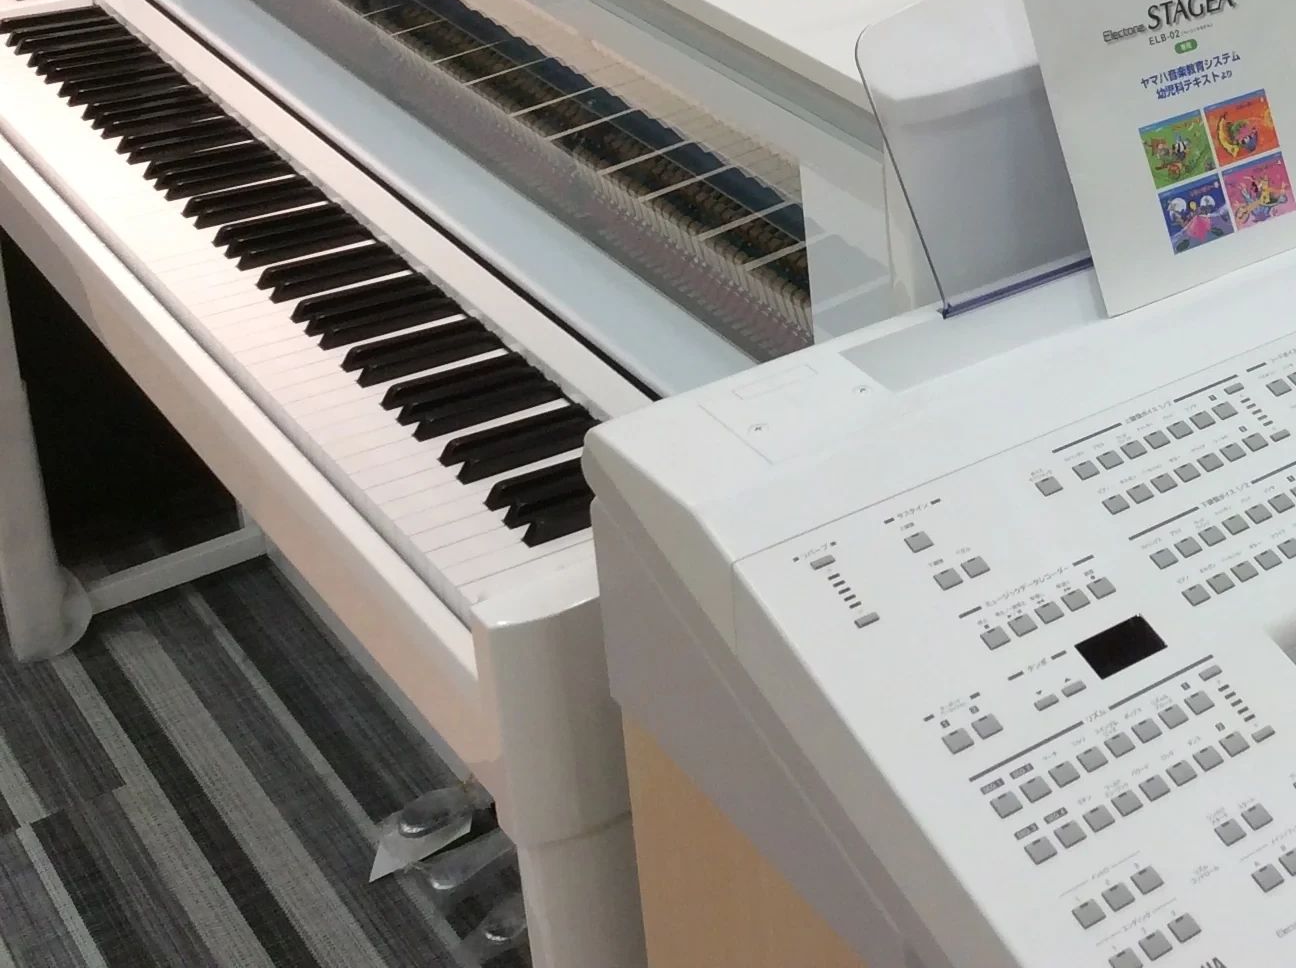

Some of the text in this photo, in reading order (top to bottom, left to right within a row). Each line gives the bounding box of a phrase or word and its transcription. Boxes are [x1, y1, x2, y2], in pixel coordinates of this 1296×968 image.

[1149, 30, 1181, 46] ELB-02
[1140, 51, 1241, 89] ヤマハ音楽教育システム
[1156, 69, 1233, 100] 幼児科テキストより
